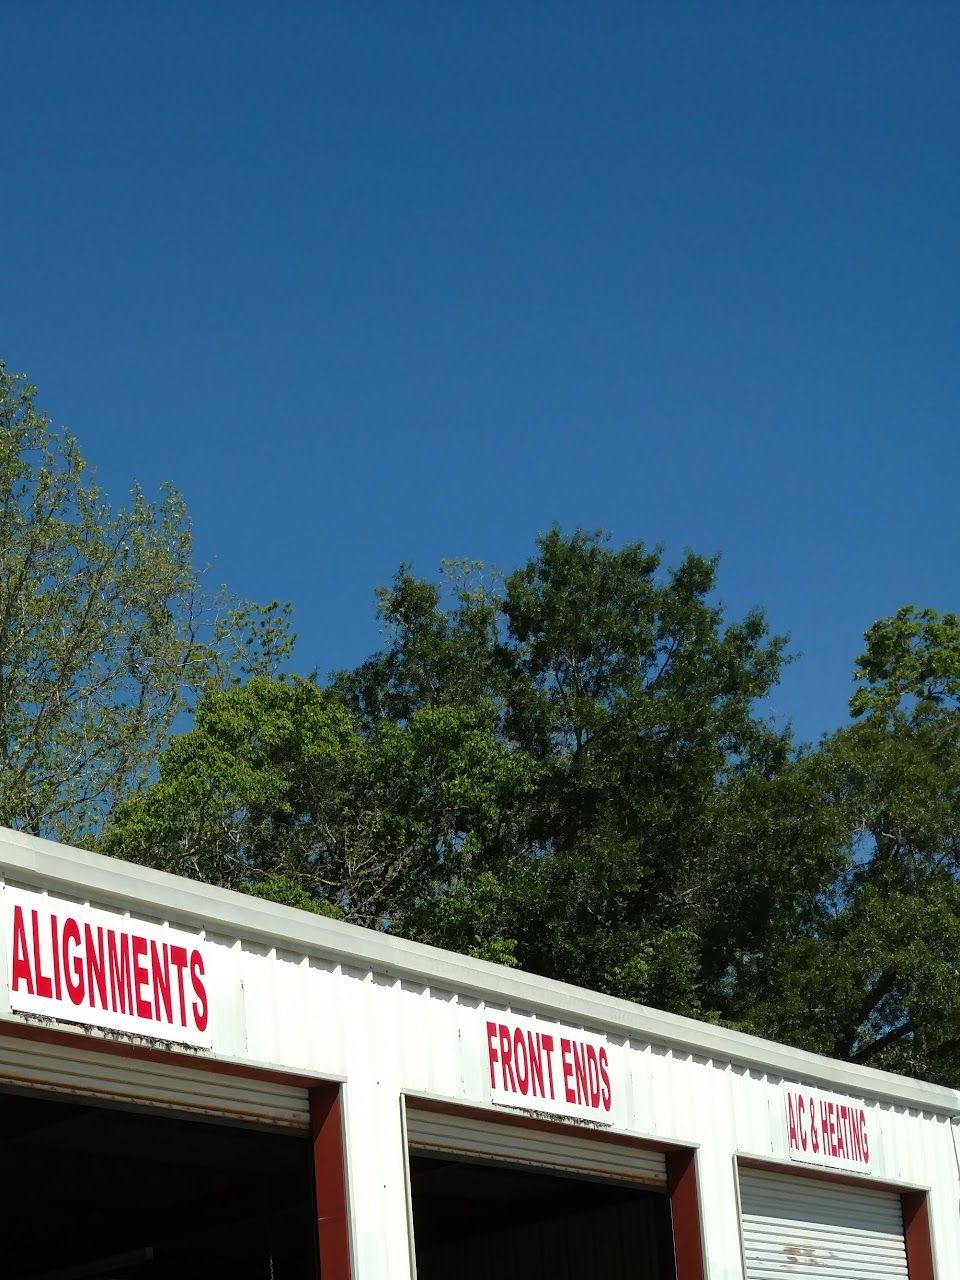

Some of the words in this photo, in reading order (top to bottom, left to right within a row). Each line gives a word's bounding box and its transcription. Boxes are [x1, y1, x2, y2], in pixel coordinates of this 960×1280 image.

[11, 904, 209, 1032] ALIGNMENTS
[486, 1021, 555, 1100] FRONT
[560, 1038, 612, 1112] ENDS
[810, 1097, 819, 1154] &
[820, 1100, 870, 1164] HEATING
